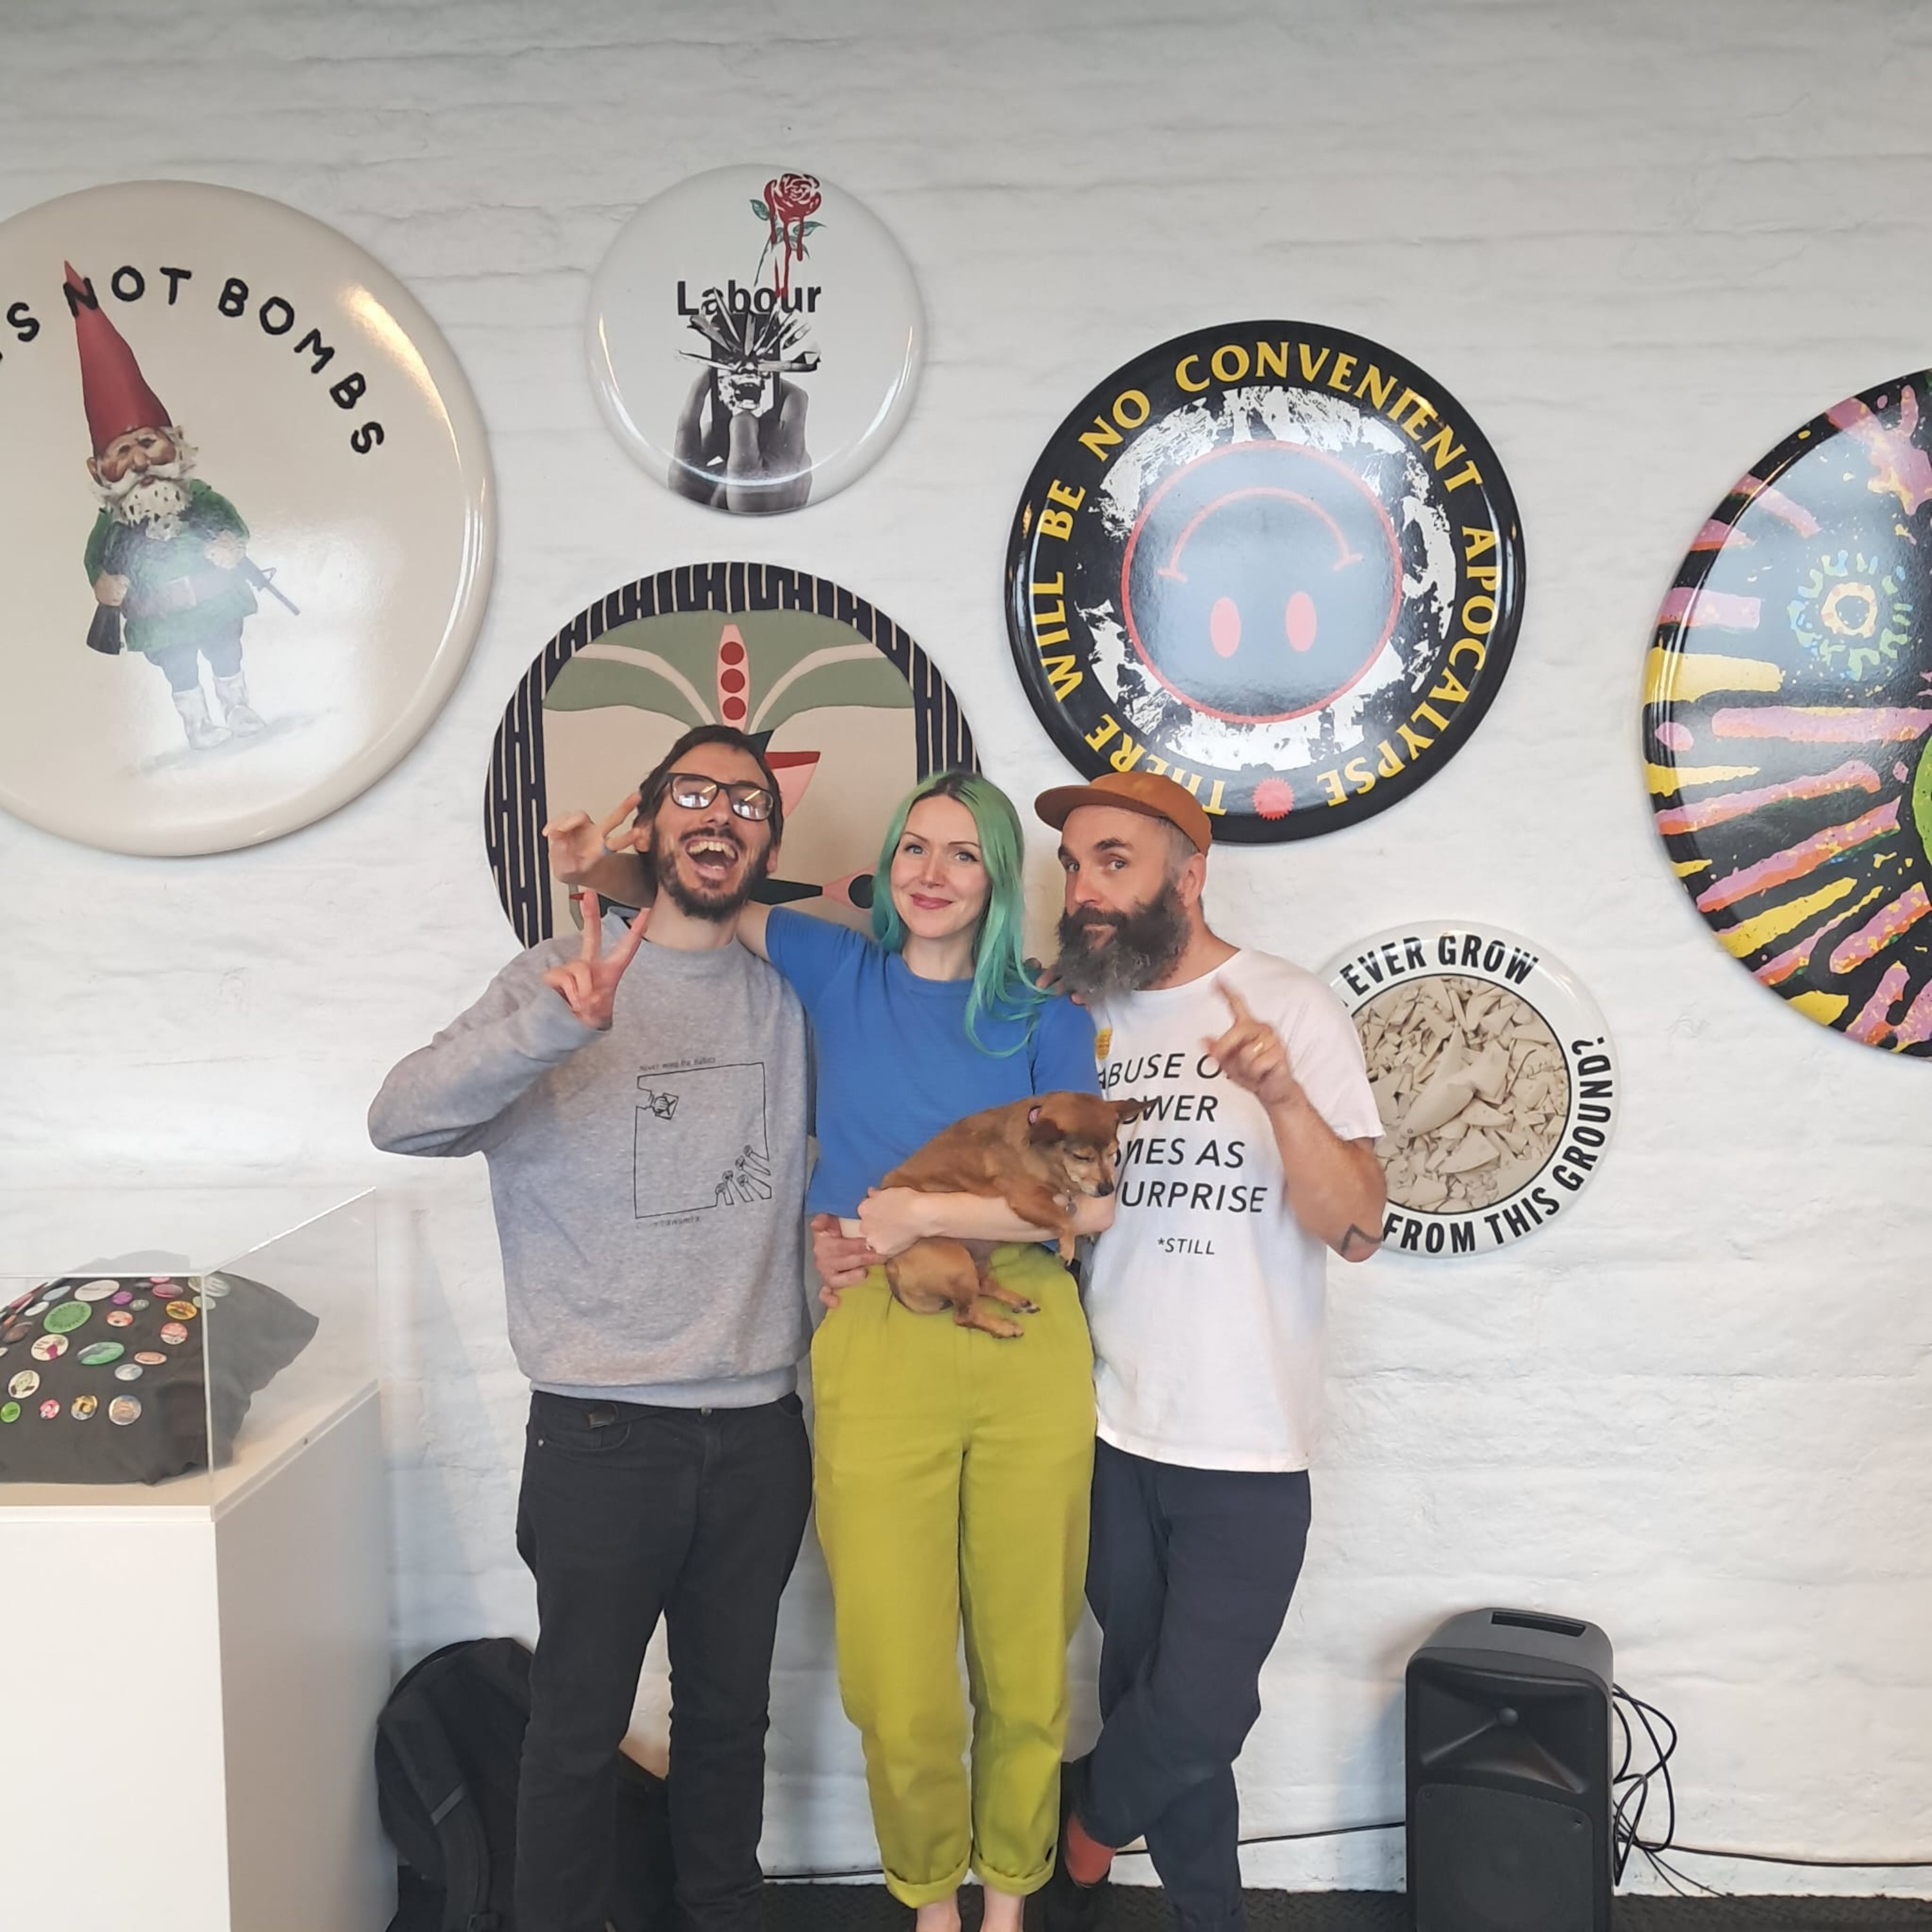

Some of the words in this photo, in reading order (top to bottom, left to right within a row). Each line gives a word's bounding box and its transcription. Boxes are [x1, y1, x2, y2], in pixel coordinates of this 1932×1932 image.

[677, 279, 822, 316] Labour
[62, 265, 192, 317] NOT
[218, 278, 384, 454] BOMBS
[1078, 389, 1151, 462] NO
[1174, 341, 1483, 493] CONVENIENT
[1039, 478, 1086, 542] BE
[1030, 571, 1084, 703] WILL
[1316, 525, 1502, 807] APOCALYPSE
[1339, 936, 1427, 997] EVER
[1438, 934, 1540, 985] GROW
[1098, 1052, 1186, 1090] ABUSE
[1196, 1052, 1232, 1080] O
[1119, 1094, 1218, 1126] WER
[1195, 1139, 1245, 1168] AS
[1383, 1212, 1476, 1254] FROM
[1483, 1186, 1560, 1245] THIS
[1552, 1036, 1613, 1192] GROUND?
[1121, 1180, 1268, 1213] URPRISE
